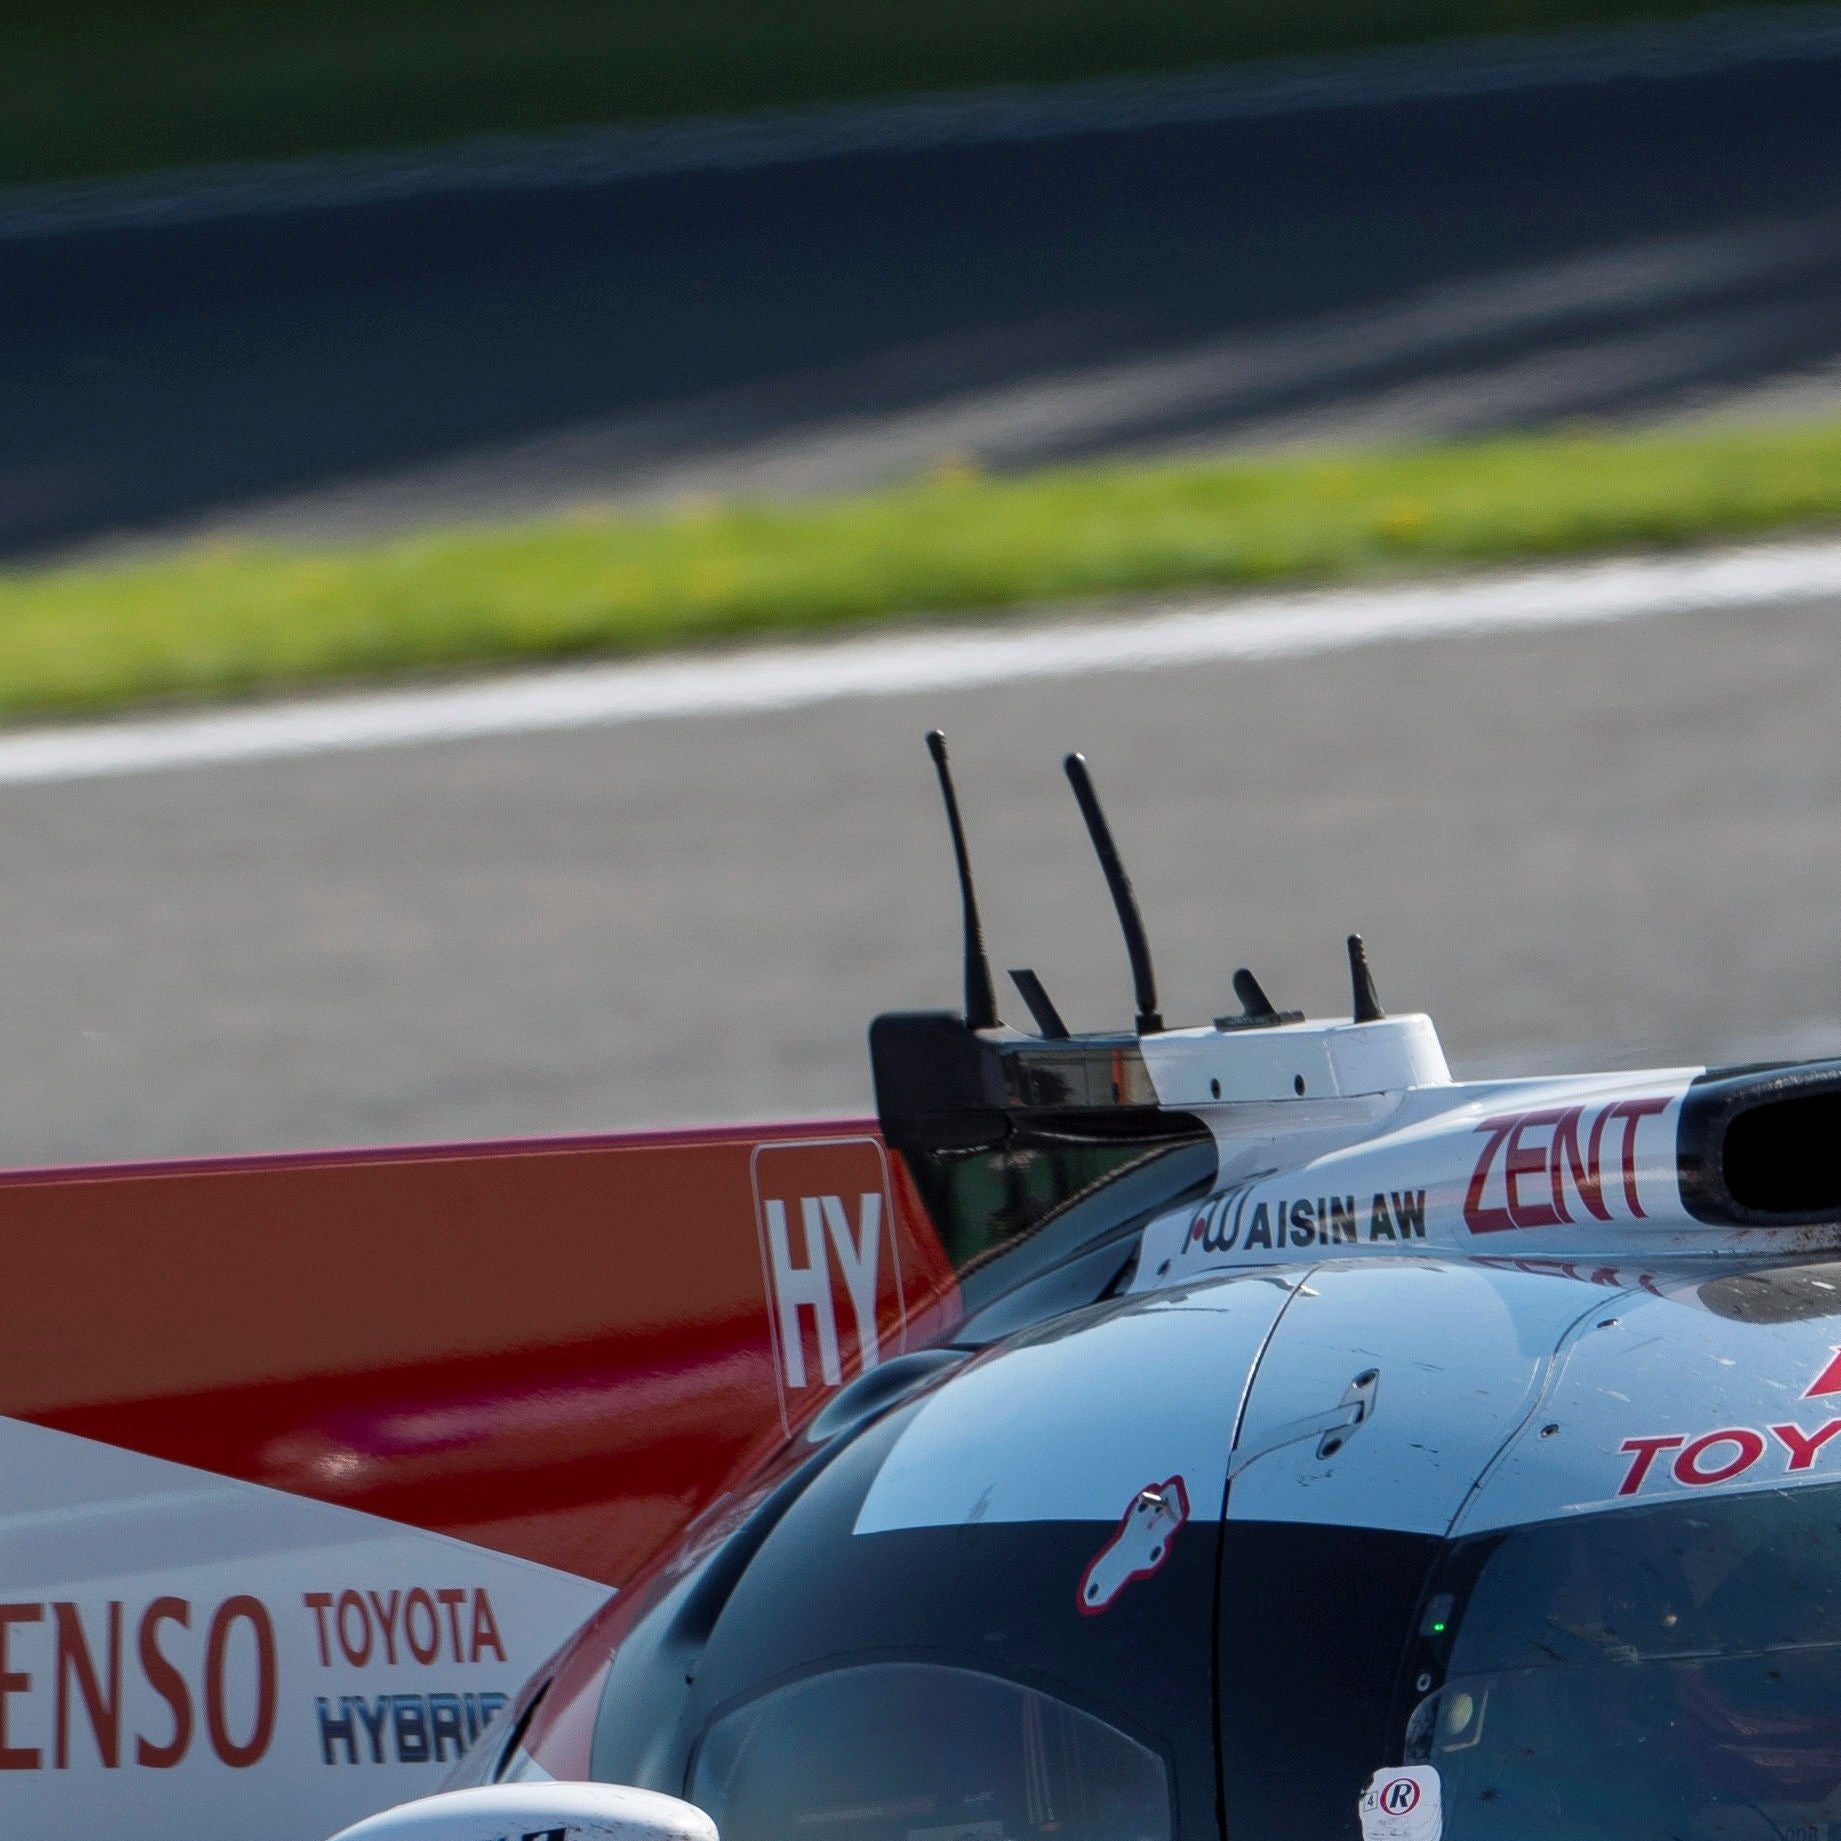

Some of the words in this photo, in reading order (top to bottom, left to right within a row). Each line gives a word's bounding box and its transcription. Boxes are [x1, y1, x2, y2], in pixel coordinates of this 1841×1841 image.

[1462, 1097, 1674, 1234] ZENT
[1244, 1196, 1357, 1250] AISIN
[1370, 1190, 1426, 1242] AW
[764, 1193, 882, 1388] HY
[303, 1588, 507, 1667] TOYOTA
